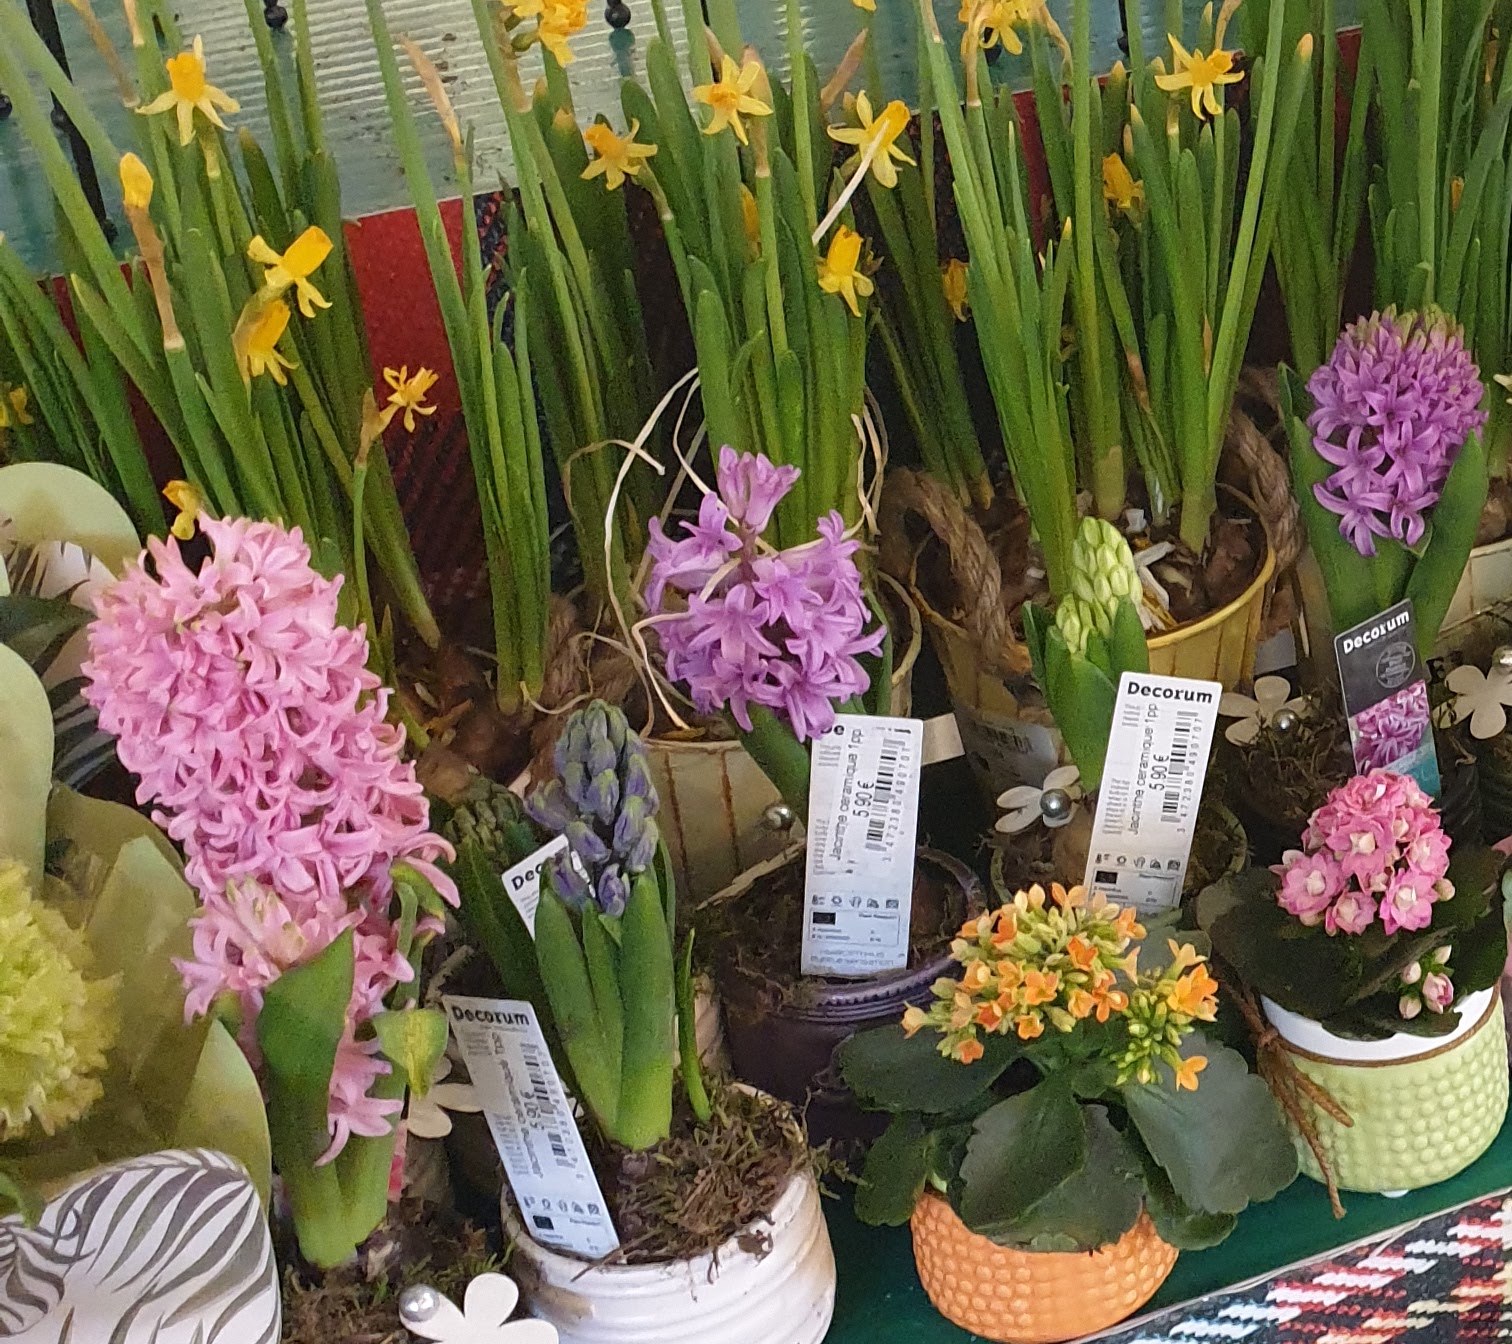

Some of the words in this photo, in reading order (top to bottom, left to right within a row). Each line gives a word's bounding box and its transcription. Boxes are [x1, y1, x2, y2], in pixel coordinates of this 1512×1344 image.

[1343, 611, 1410, 655] Decorum
[1127, 680, 1213, 705] Decorum
[1135, 727, 1154, 787] ceramique
[1127, 789, 1145, 836] Jacinthe
[452, 1005, 531, 1027] Decorum
